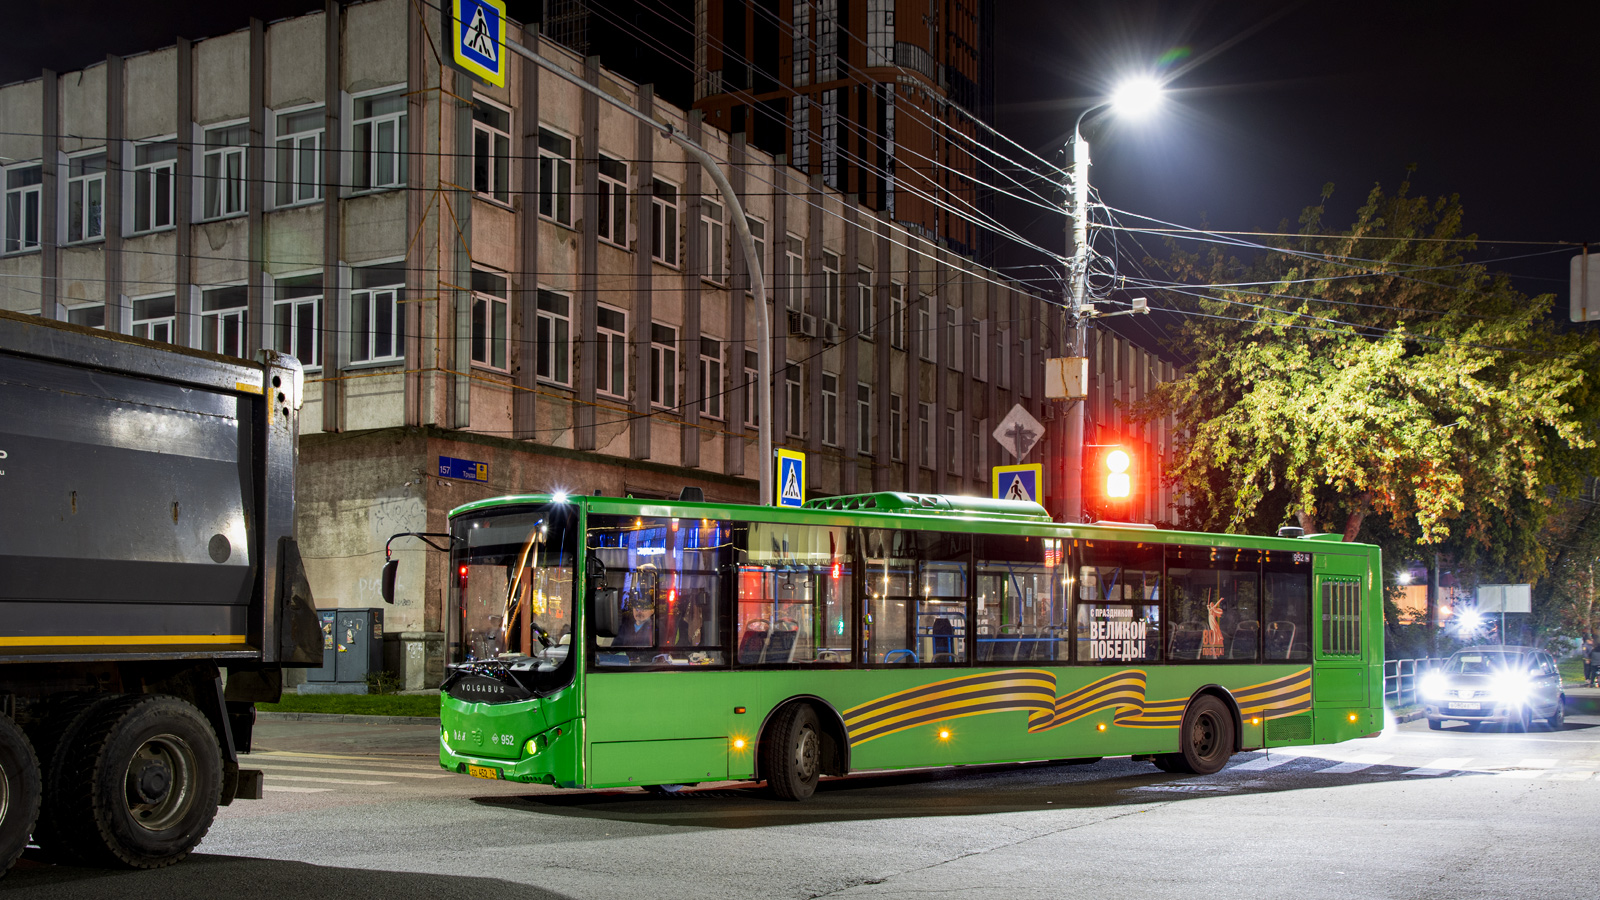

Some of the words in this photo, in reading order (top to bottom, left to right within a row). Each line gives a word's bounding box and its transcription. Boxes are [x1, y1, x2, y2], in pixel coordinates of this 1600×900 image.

[440, 465, 451, 475] 157
[1293, 553, 1305, 562] 952
[1090, 608, 1095, 618] С
[1095, 608, 1134, 619] ПРАЗДНИКОМ
[1090, 618, 1147, 640] ВЕЛИКОЙ
[1202, 629, 1216, 645] 80
[1090, 640, 1146, 661] ПОБЕДЫ!
[461, 683, 505, 694] VOLGABUS
[500, 734, 515, 746] 952
